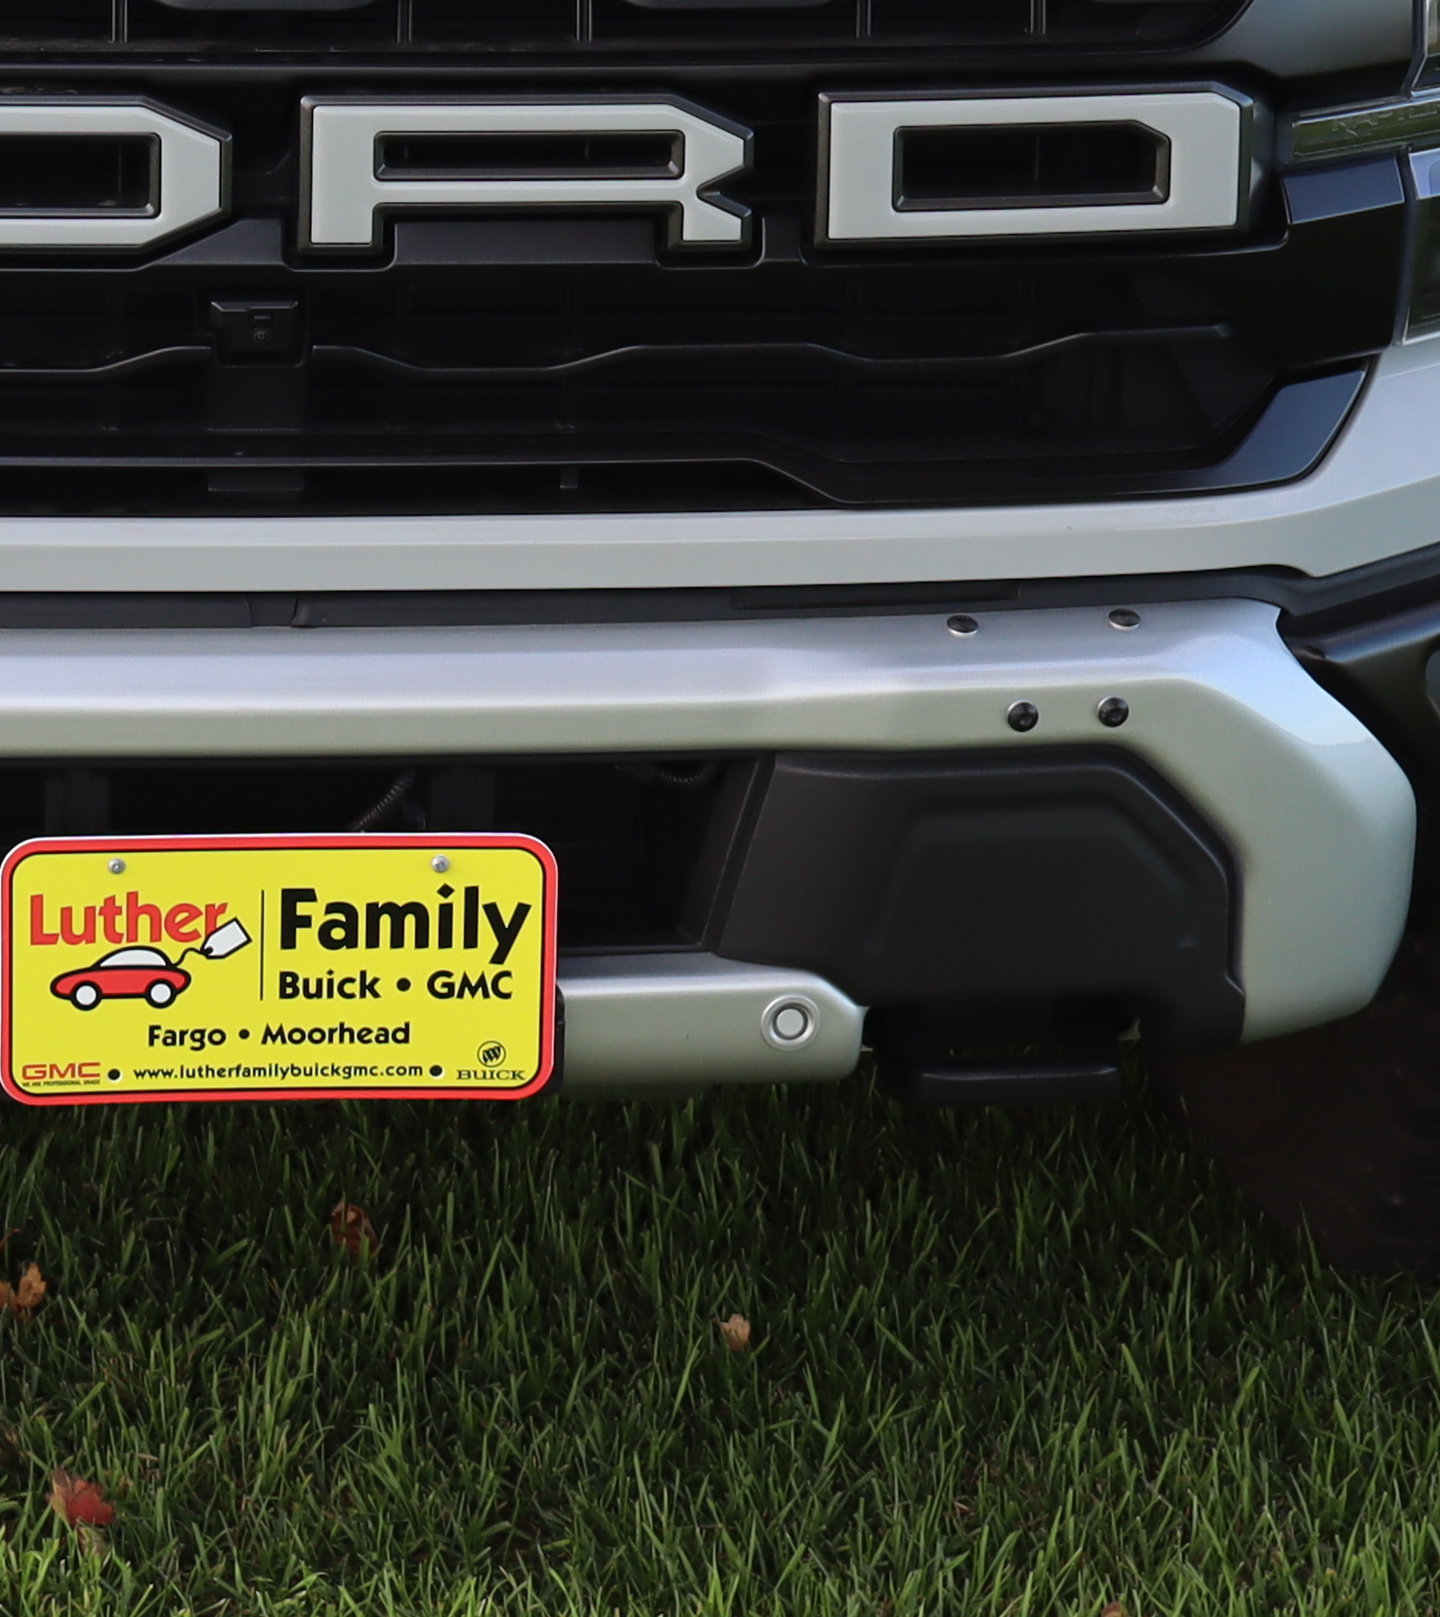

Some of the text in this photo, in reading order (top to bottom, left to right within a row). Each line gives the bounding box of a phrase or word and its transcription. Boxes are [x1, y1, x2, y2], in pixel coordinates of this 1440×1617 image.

[29, 883, 532, 965] Luther Family
[278, 968, 513, 1001] Buick GMC
[147, 1021, 411, 1052] Fargo Moorhead
[21, 1061, 526, 1081] GMC www.lutherfamilybuickgmc.com BUICK
